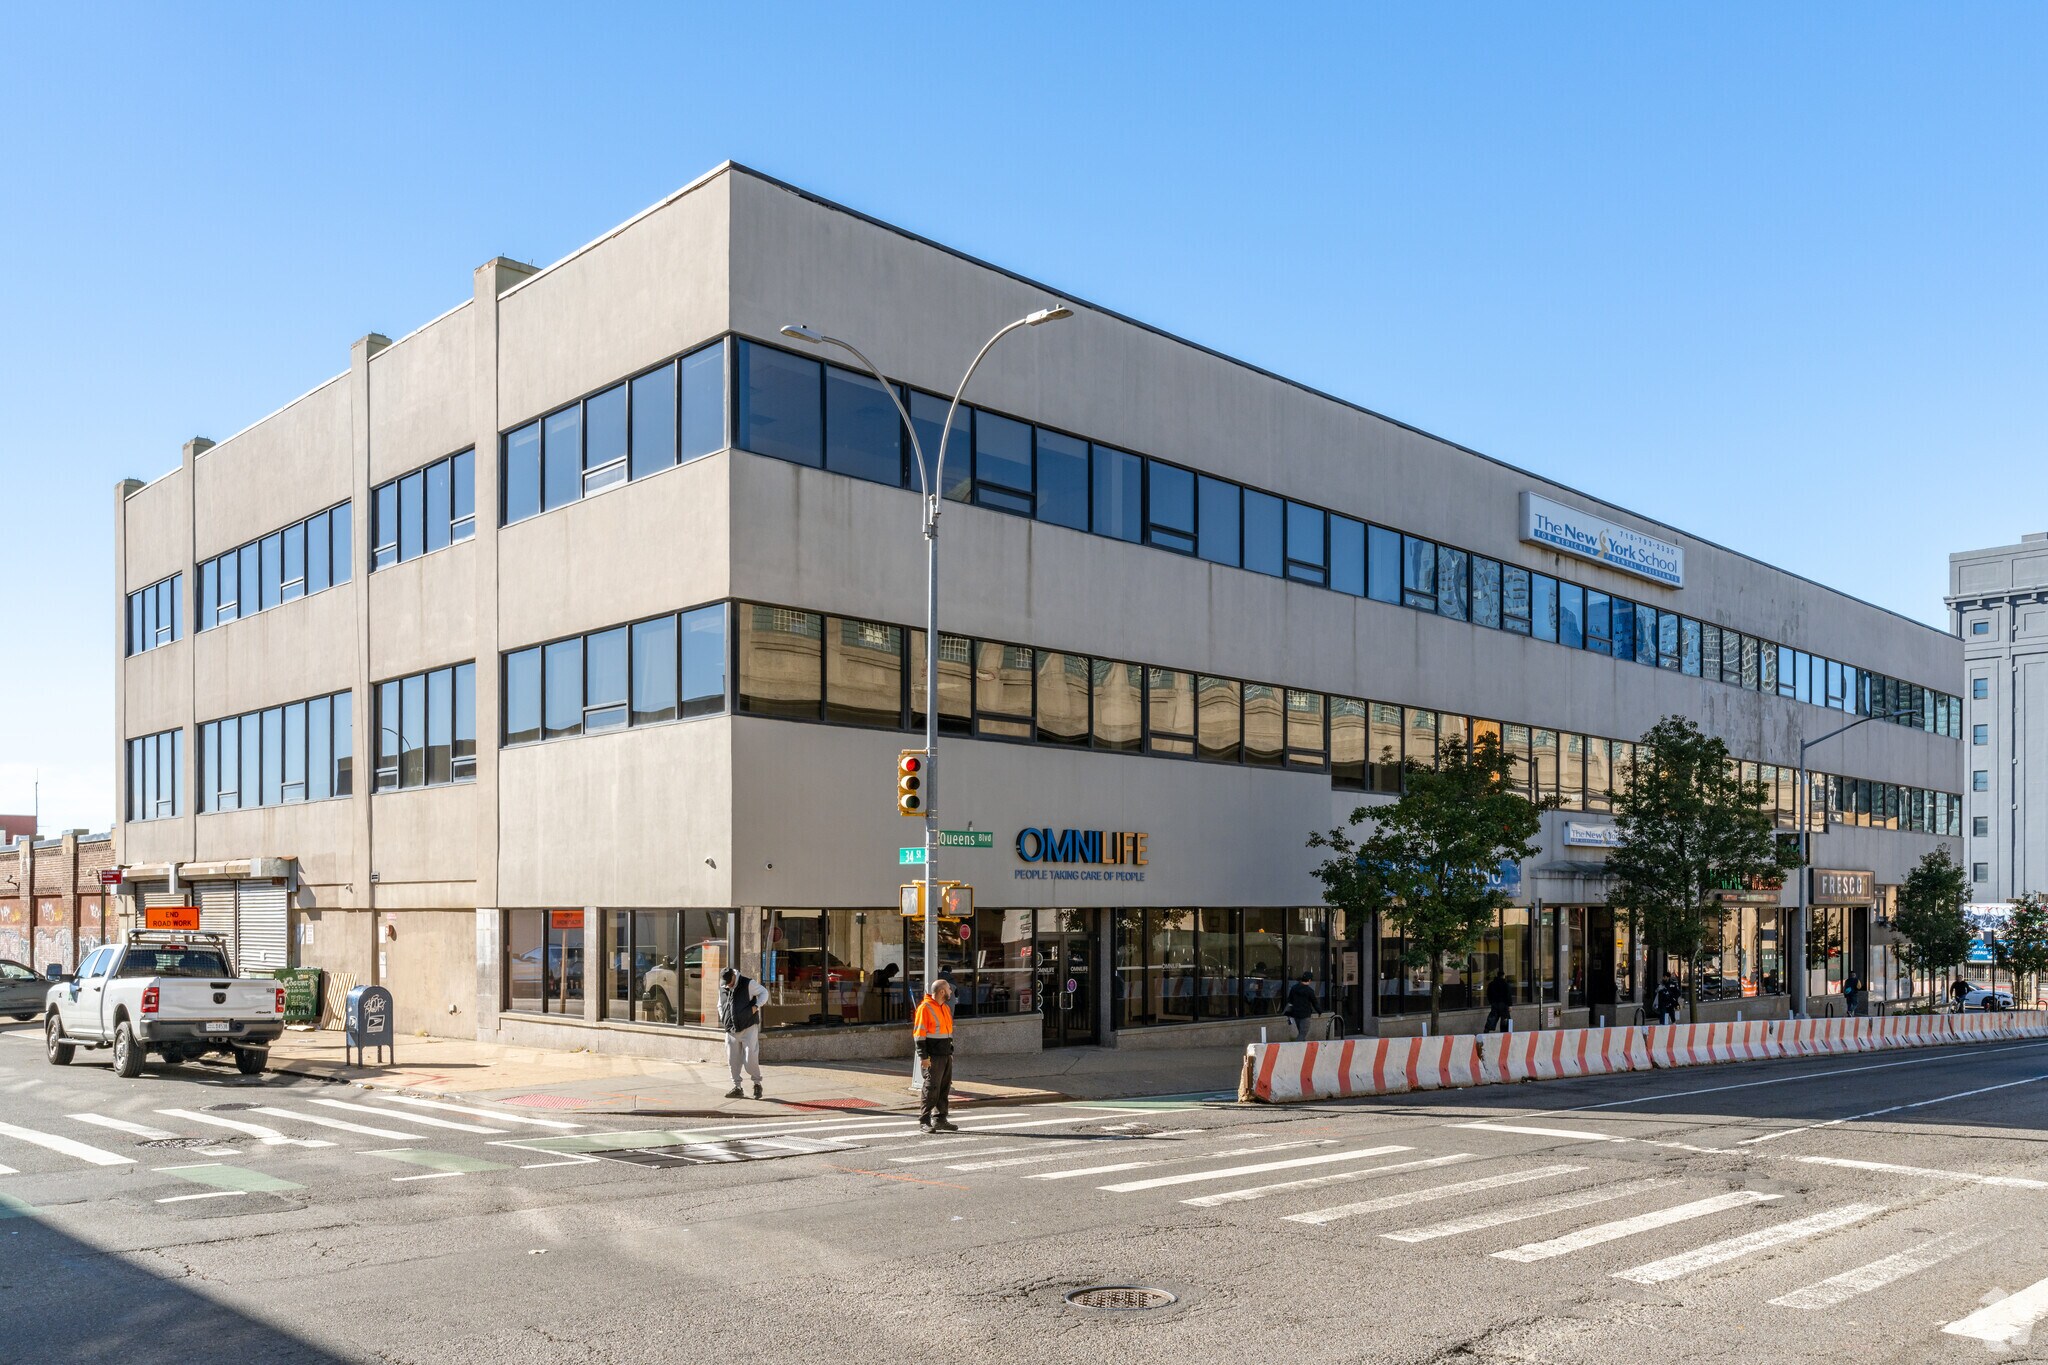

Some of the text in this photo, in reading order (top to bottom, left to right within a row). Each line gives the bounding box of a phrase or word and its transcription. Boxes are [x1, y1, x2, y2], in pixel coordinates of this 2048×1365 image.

[1535, 513, 1678, 573] The New York School
[1537, 530, 1551, 541] FOR
[1555, 537, 1586, 552] MEDICAL
[1612, 556, 1637, 569] DENTAL
[1640, 565, 1678, 582] ASSISTANTS
[940, 832, 992, 845] Queens Blvd
[1572, 829, 1585, 838] The
[1586, 830, 1602, 839] New
[1016, 827, 1148, 865] OMNILIFE
[905, 850, 914, 863] 34
[1014, 869, 1145, 881] PEOPLE TAKING CARE OF PEOPLE
